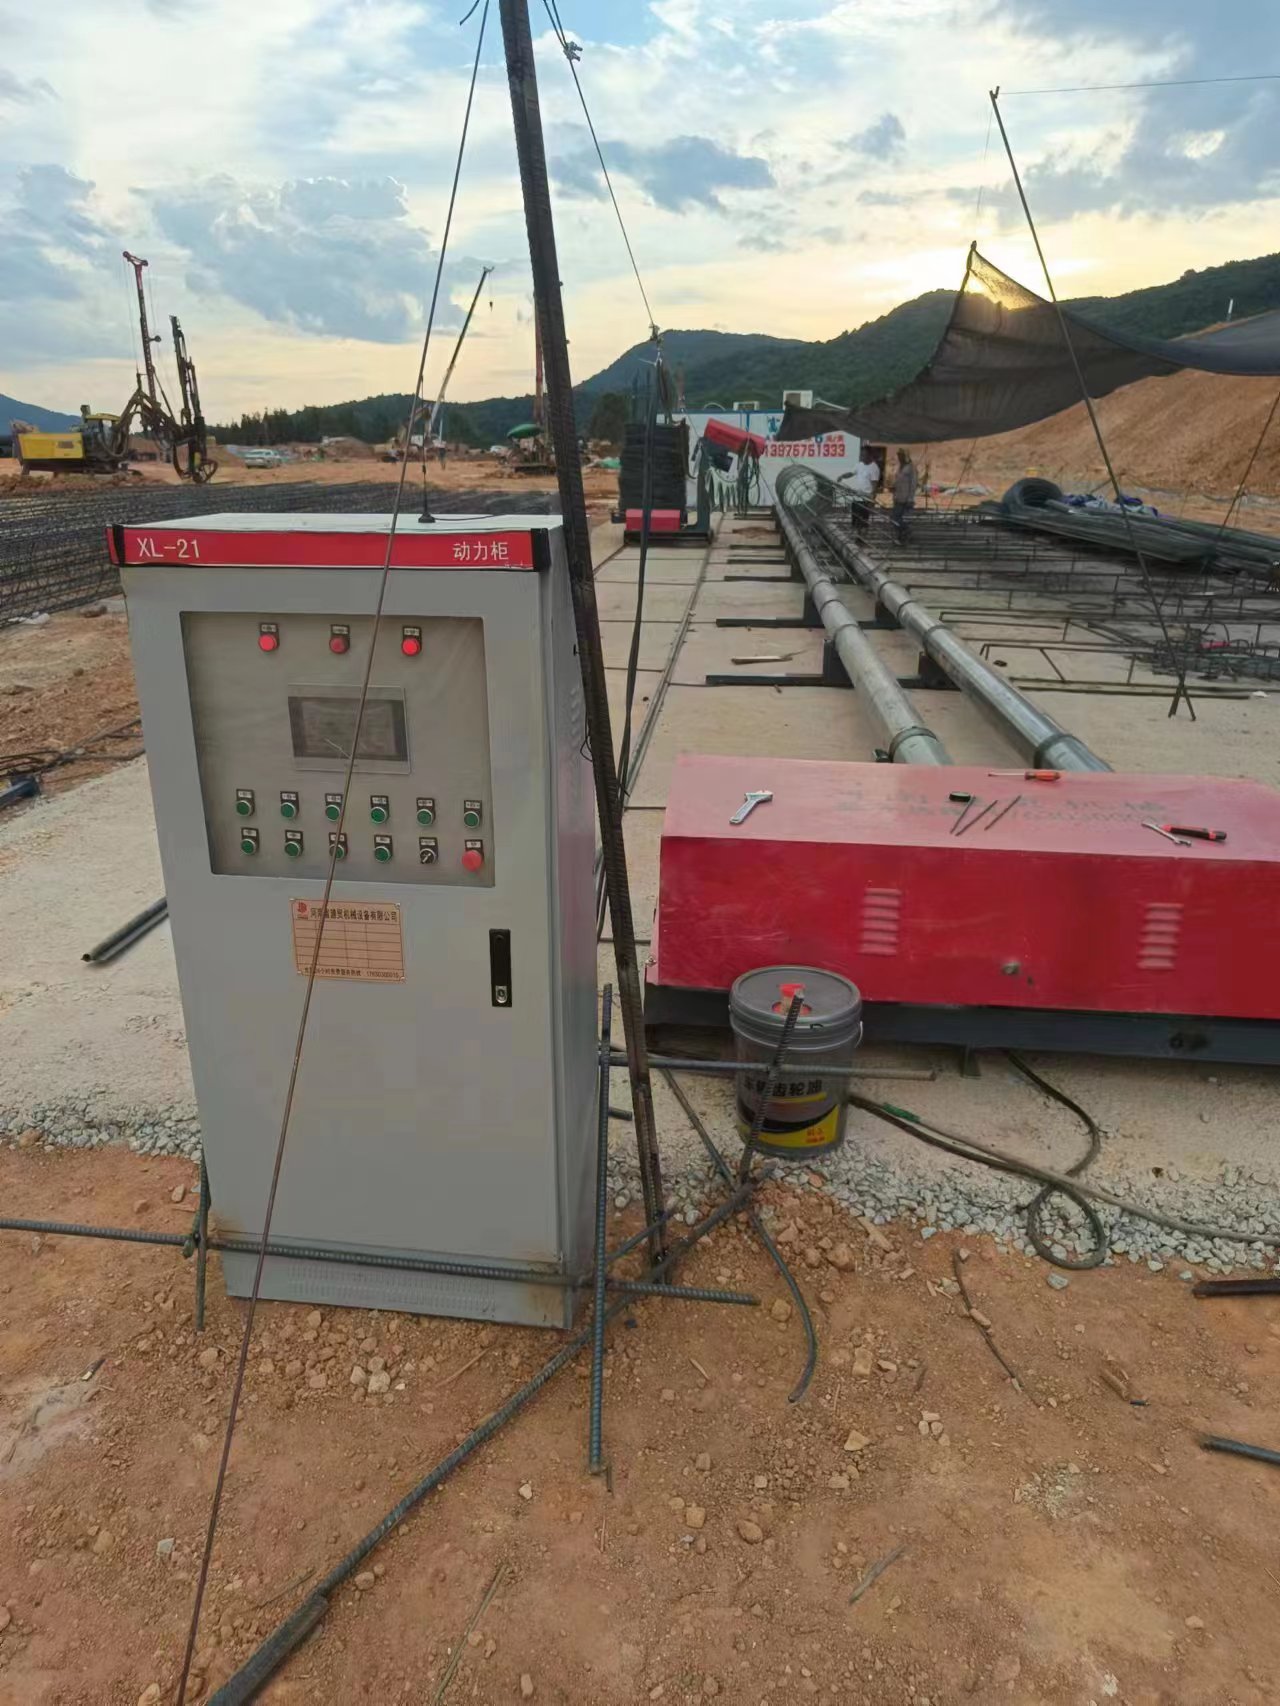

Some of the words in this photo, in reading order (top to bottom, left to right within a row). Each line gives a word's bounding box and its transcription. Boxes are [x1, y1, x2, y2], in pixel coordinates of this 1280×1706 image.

[137, 537, 199, 558] XL-21
[453, 541, 508, 560] 动力柜
